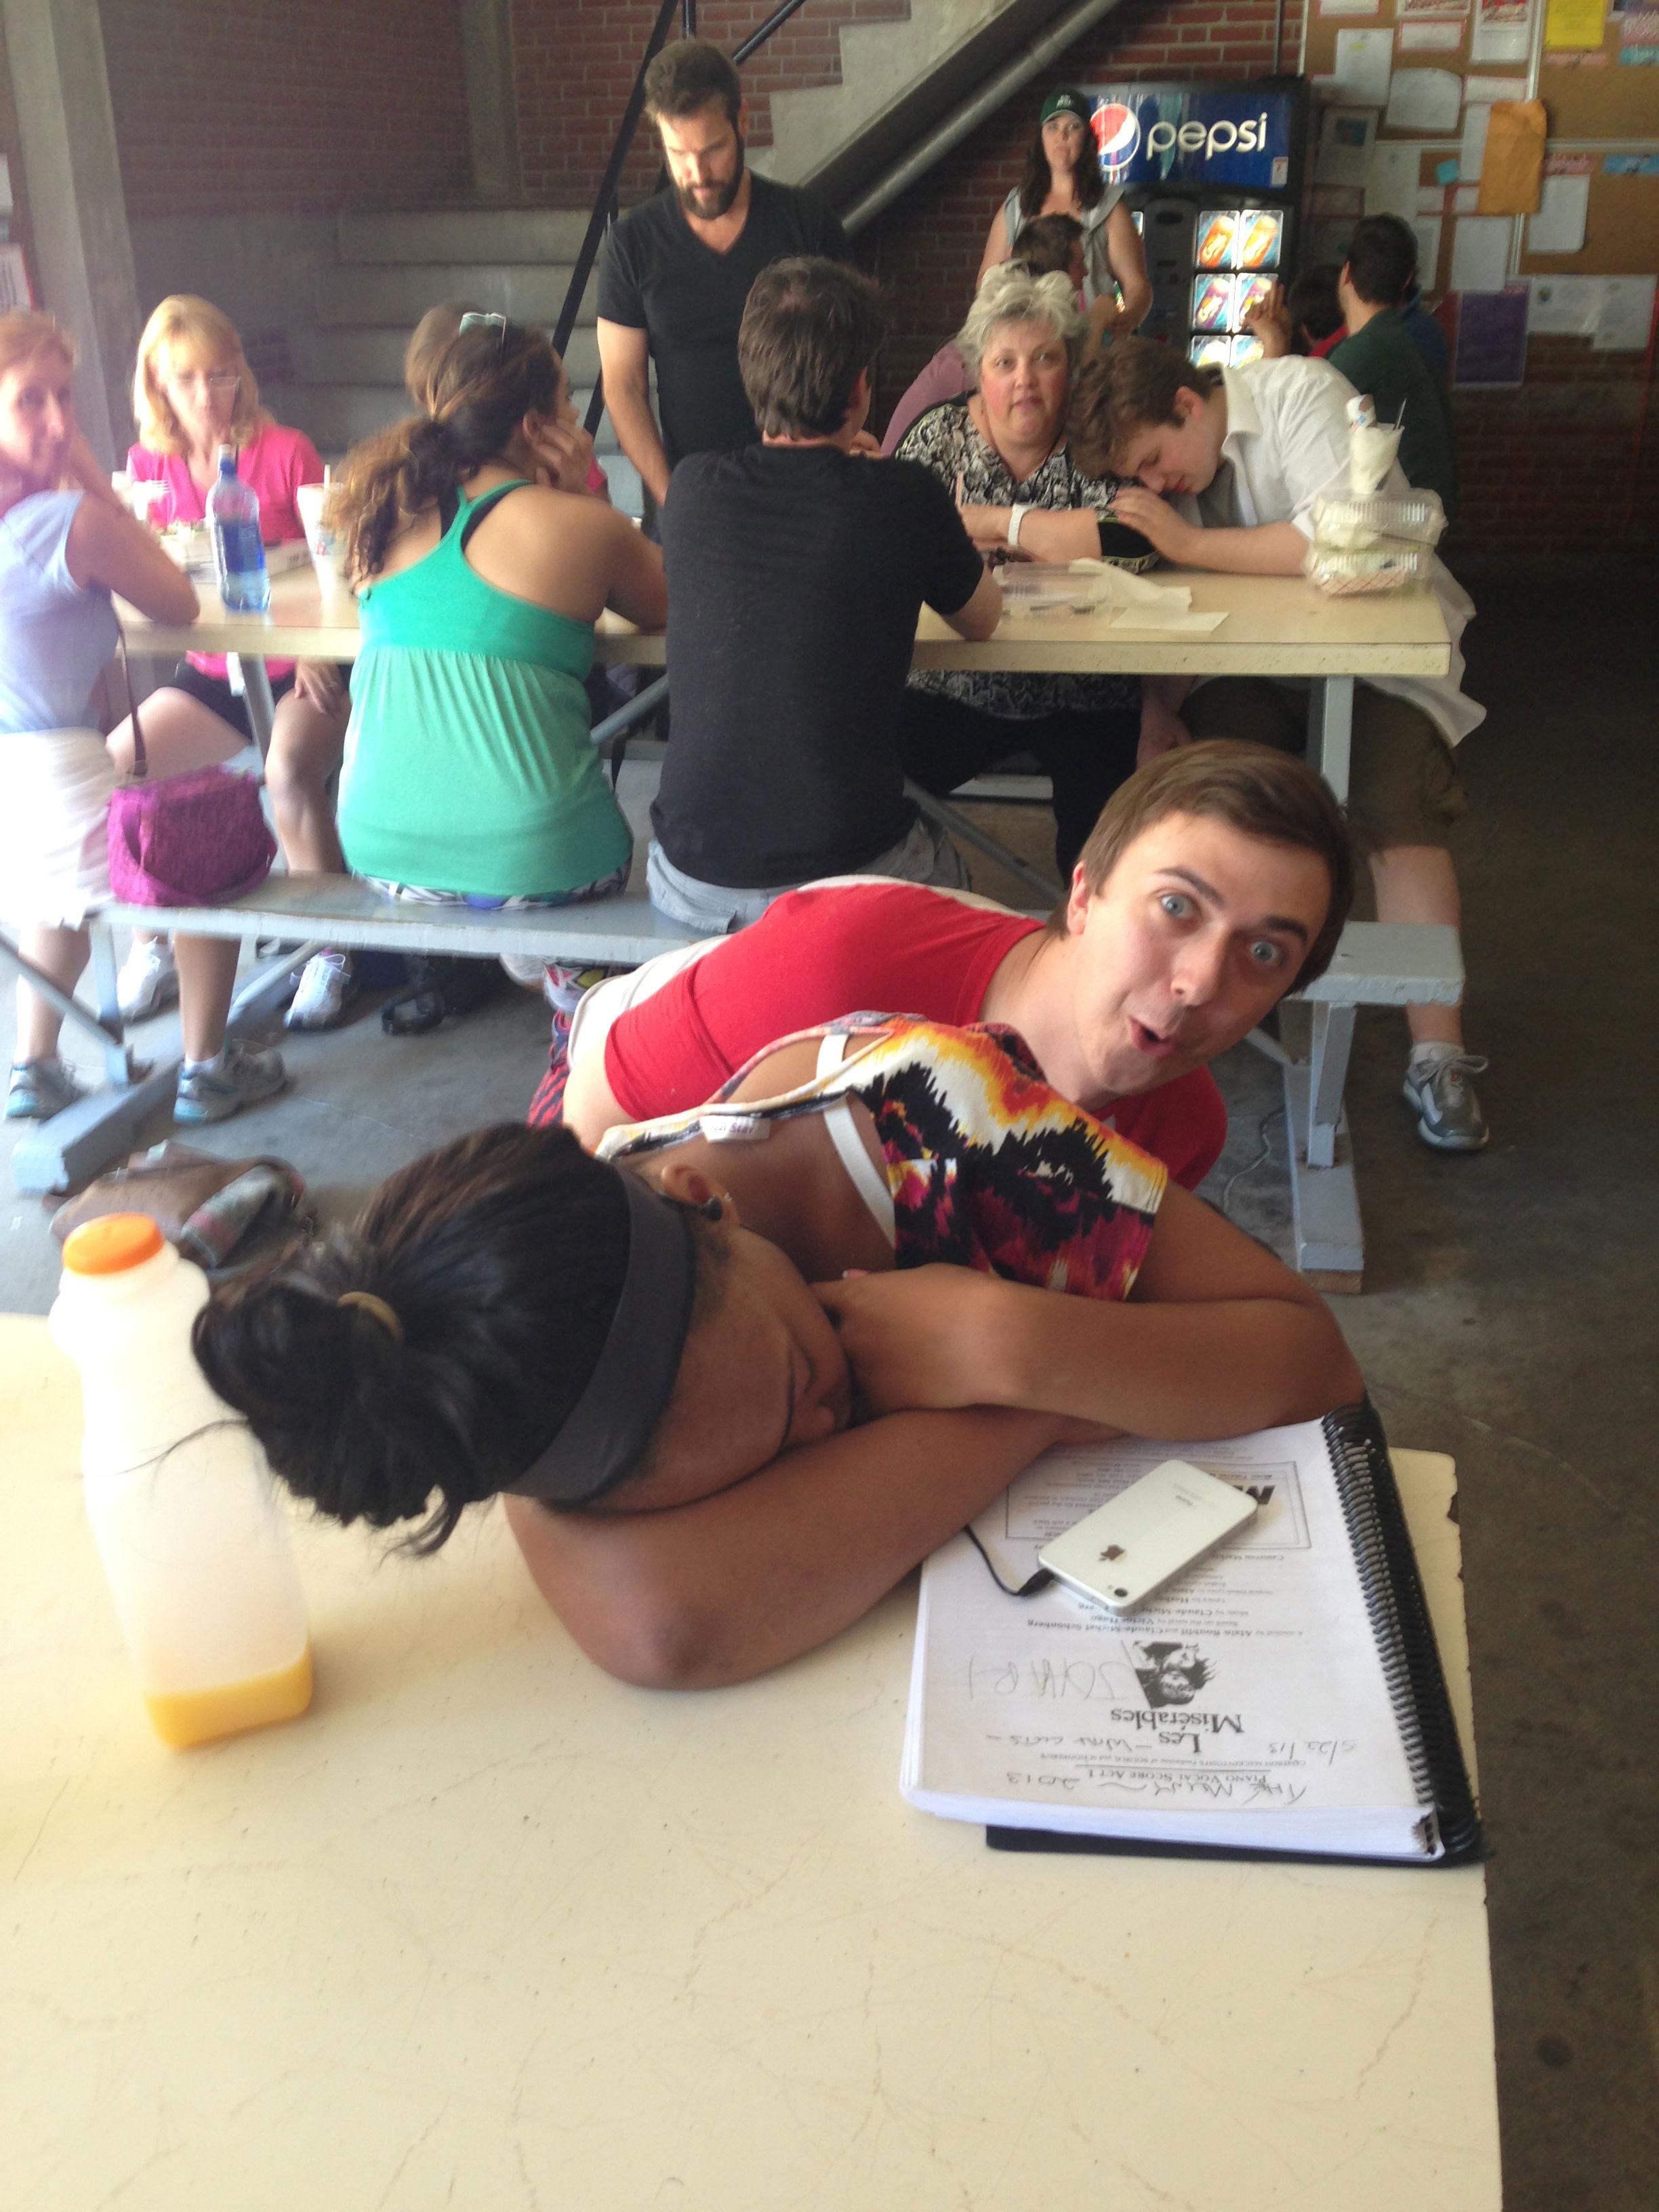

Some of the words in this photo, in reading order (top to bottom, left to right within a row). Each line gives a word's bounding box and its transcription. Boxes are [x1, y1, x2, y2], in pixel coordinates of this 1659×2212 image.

[1146, 112, 1268, 161] pepsi
[1089, 1615, 1118, 1623] Hugo
[1085, 1624, 1164, 1635] Claude-Michel
[1110, 1708, 1245, 1735] Misérables
[1158, 1732, 1202, 1755] Les
[1099, 1771, 1124, 1780] ACT
[1130, 1772, 1172, 1781] SCORE
[1177, 1774, 1220, 1783] VOCAL
[1225, 1775, 1267, 1784] PIANO
[1006, 1771, 1081, 1791] 2013
